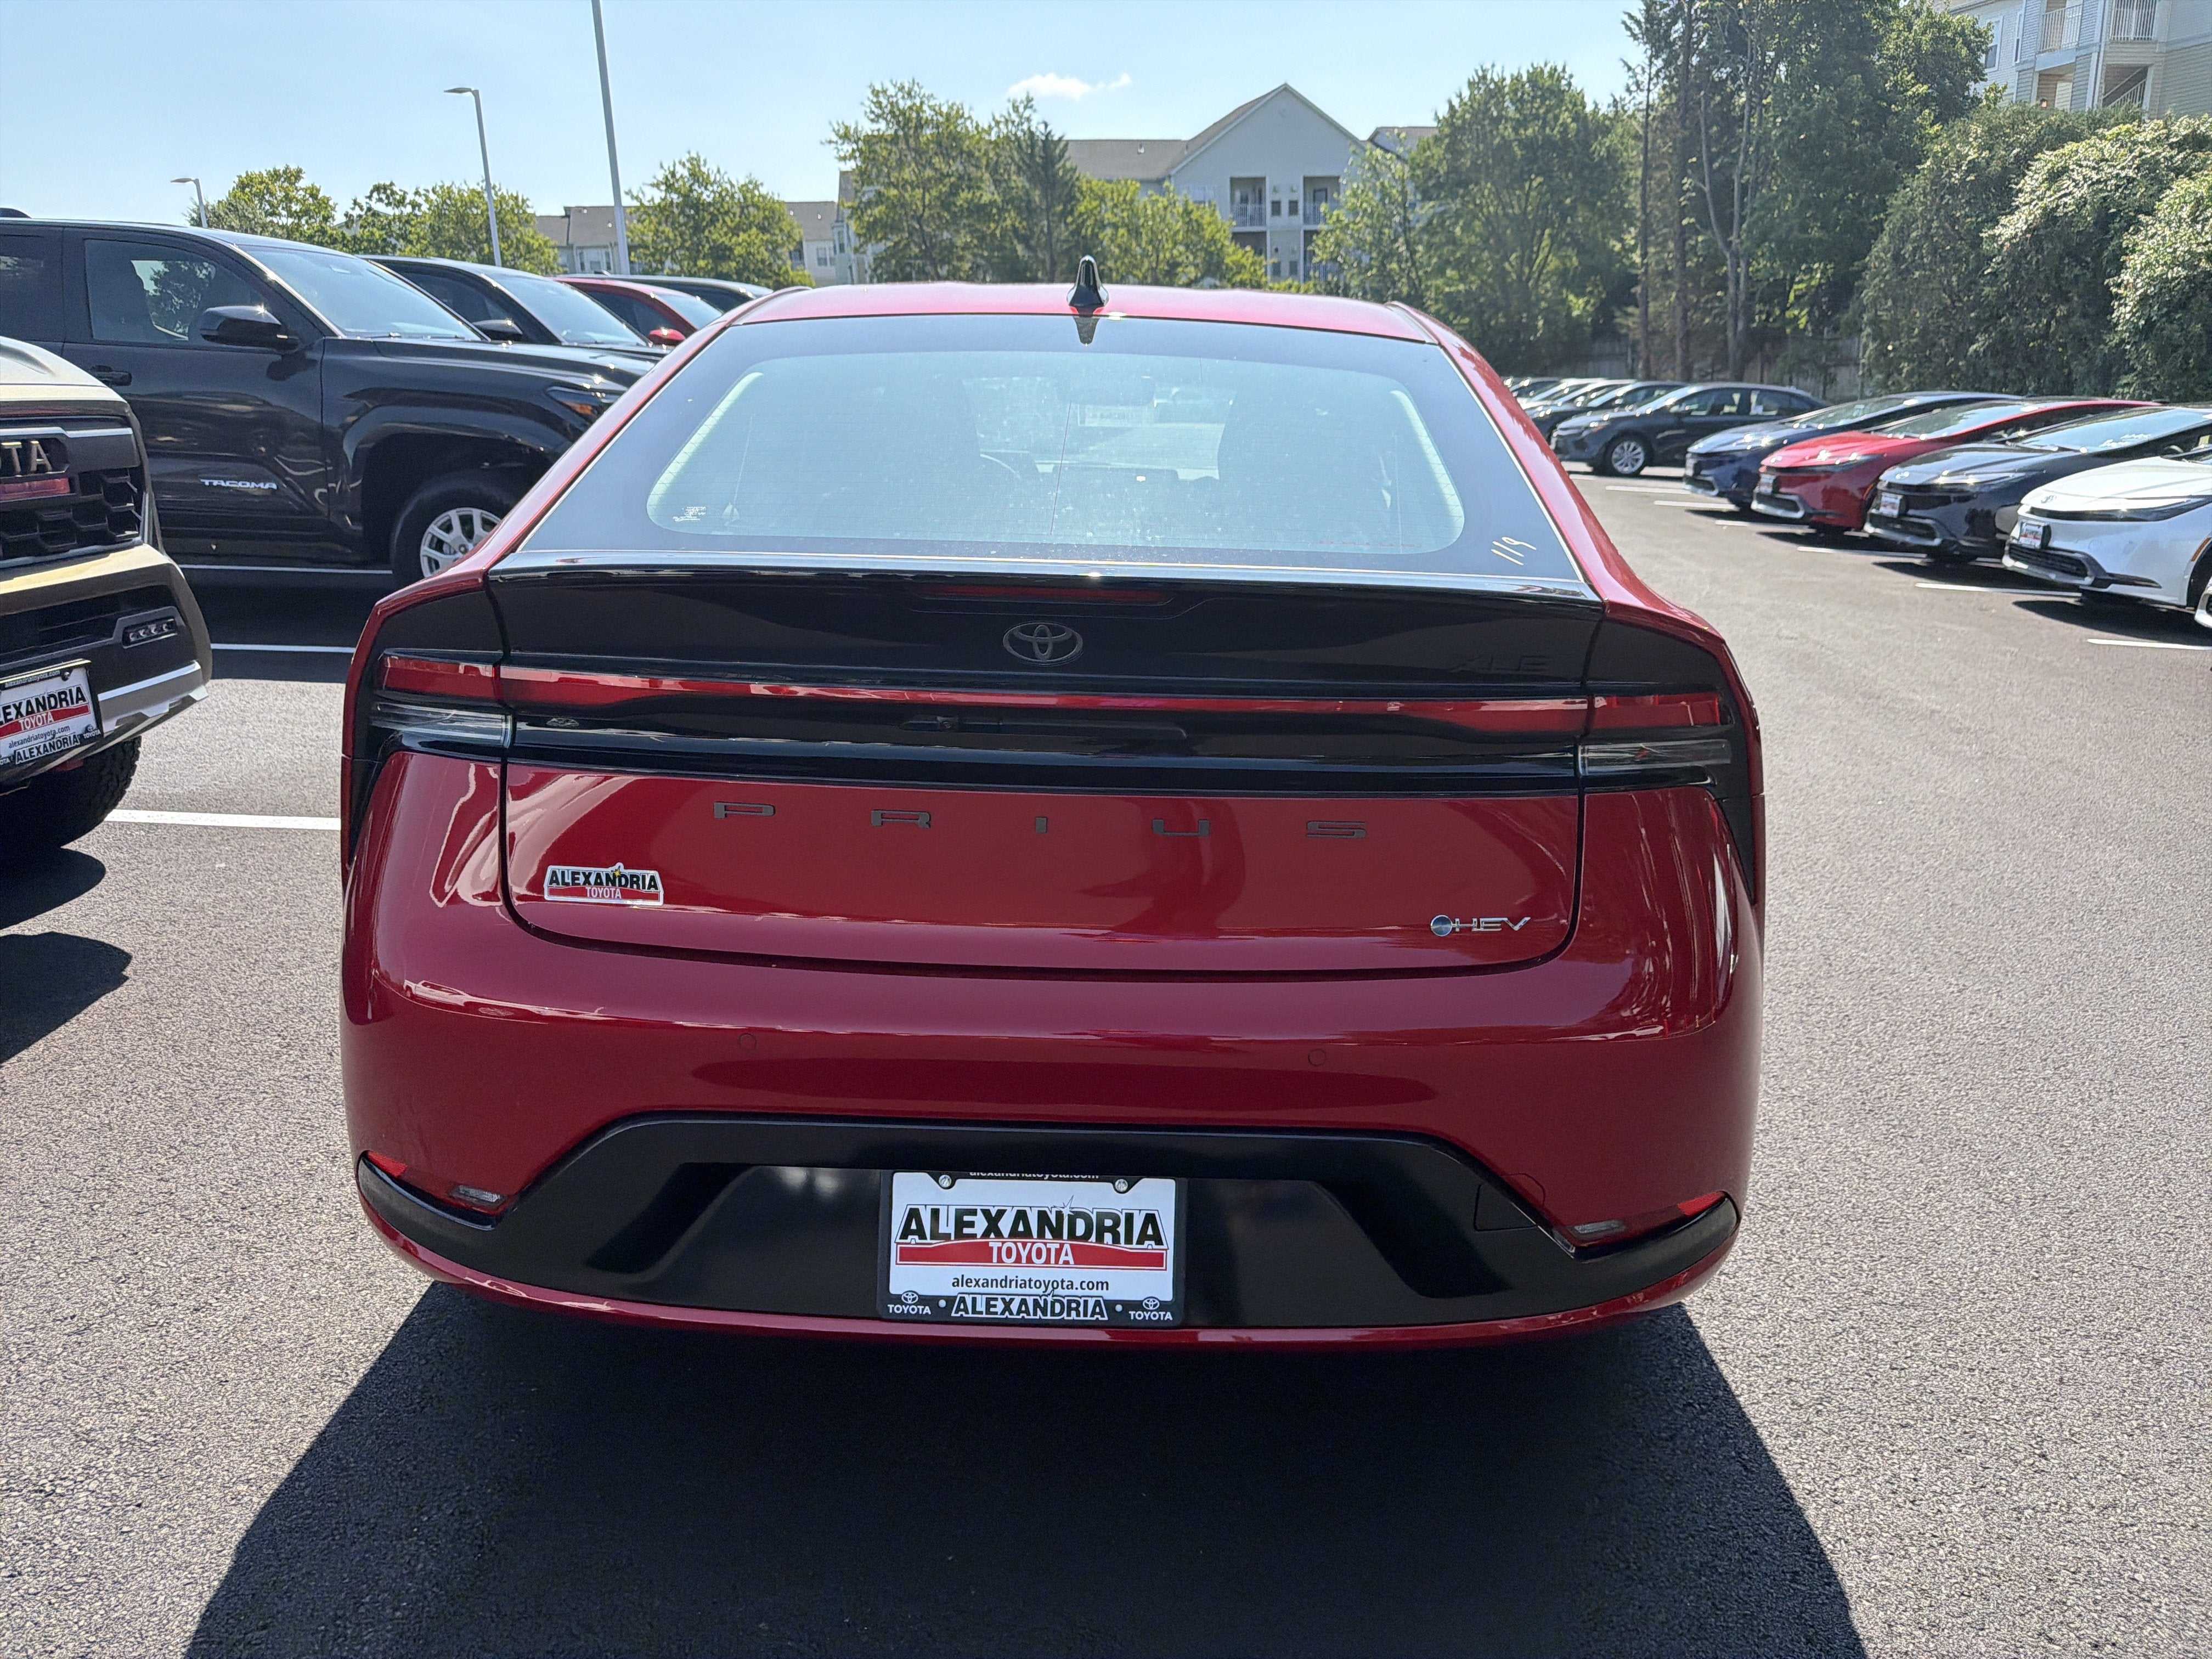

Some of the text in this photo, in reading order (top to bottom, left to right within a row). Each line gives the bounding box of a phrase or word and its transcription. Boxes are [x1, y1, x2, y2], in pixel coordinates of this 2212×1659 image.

[200, 478, 278, 490] TACOMA
[18, 712, 54, 731] TOYOTA
[8, 725, 71, 749] alexandriatoyota.com
[15, 734, 80, 764] ALEXANDRIA
[83, 729, 101, 739] TOYOTA
[714, 802, 1367, 839] PRIUS
[549, 870, 659, 891] ALEXANDRIA
[585, 886, 622, 899] TOYOTA
[898, 1207, 1164, 1246] ALEXANDRIA
[989, 1241, 1075, 1265] TOYOTA
[951, 1274, 1110, 1294] alexandriatoyota.com
[887, 1295, 1173, 1321] TOYOTA ALEXANDRIA TOYOTA
